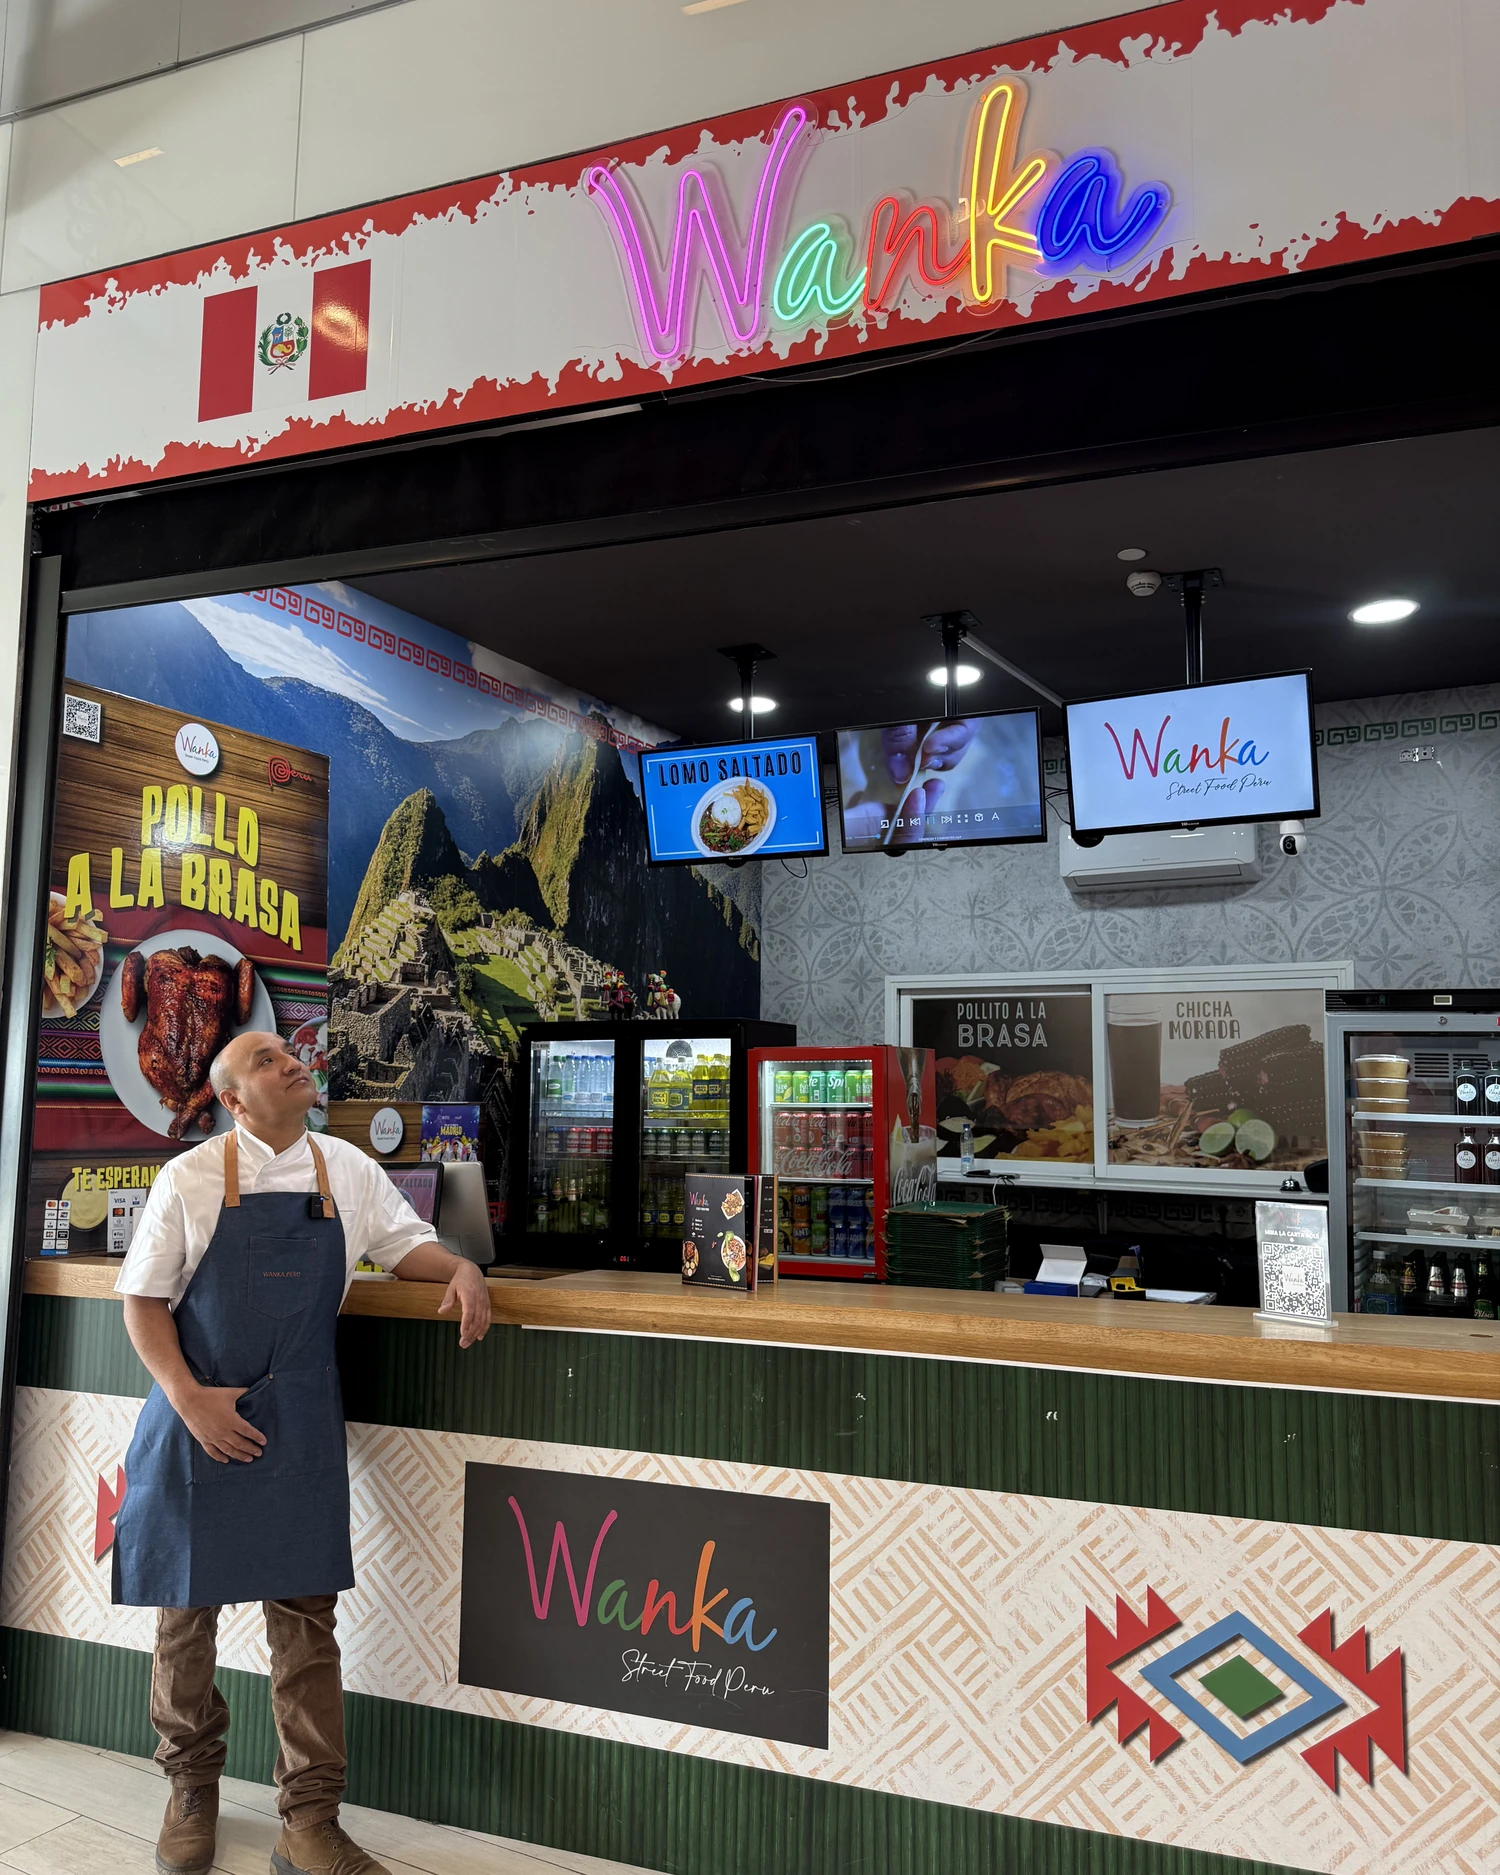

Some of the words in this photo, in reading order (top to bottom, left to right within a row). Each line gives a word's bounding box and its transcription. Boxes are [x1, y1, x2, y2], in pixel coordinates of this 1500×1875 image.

[589, 84, 1161, 360] Wanka
[179, 731, 217, 759] Wanka
[1104, 715, 1269, 780] Wanka
[658, 760, 710, 787] LOMO
[717, 750, 802, 781] SALTADO
[1166, 781, 1202, 801] Street
[1204, 777, 1238, 797] Food
[141, 783, 261, 868] POLLO
[63, 852, 94, 919] A
[110, 847, 165, 909] LA
[180, 852, 302, 952] BRASA
[957, 1001, 1010, 1020] POLLITO
[1015, 1001, 1024, 1019] A
[1030, 1000, 1047, 1019] LA
[1176, 1000, 1233, 1018] CHICHA
[958, 1023, 1048, 1048] BRASA
[1169, 1019, 1241, 1040] MORADA
[373, 1118, 402, 1136] Wanka
[72, 1167, 92, 1191] TE
[508, 1495, 778, 1653] Wanka
[621, 1647, 685, 1688] Street
[676, 1660, 725, 1696] Food
[724, 1666, 775, 1700] Peru
